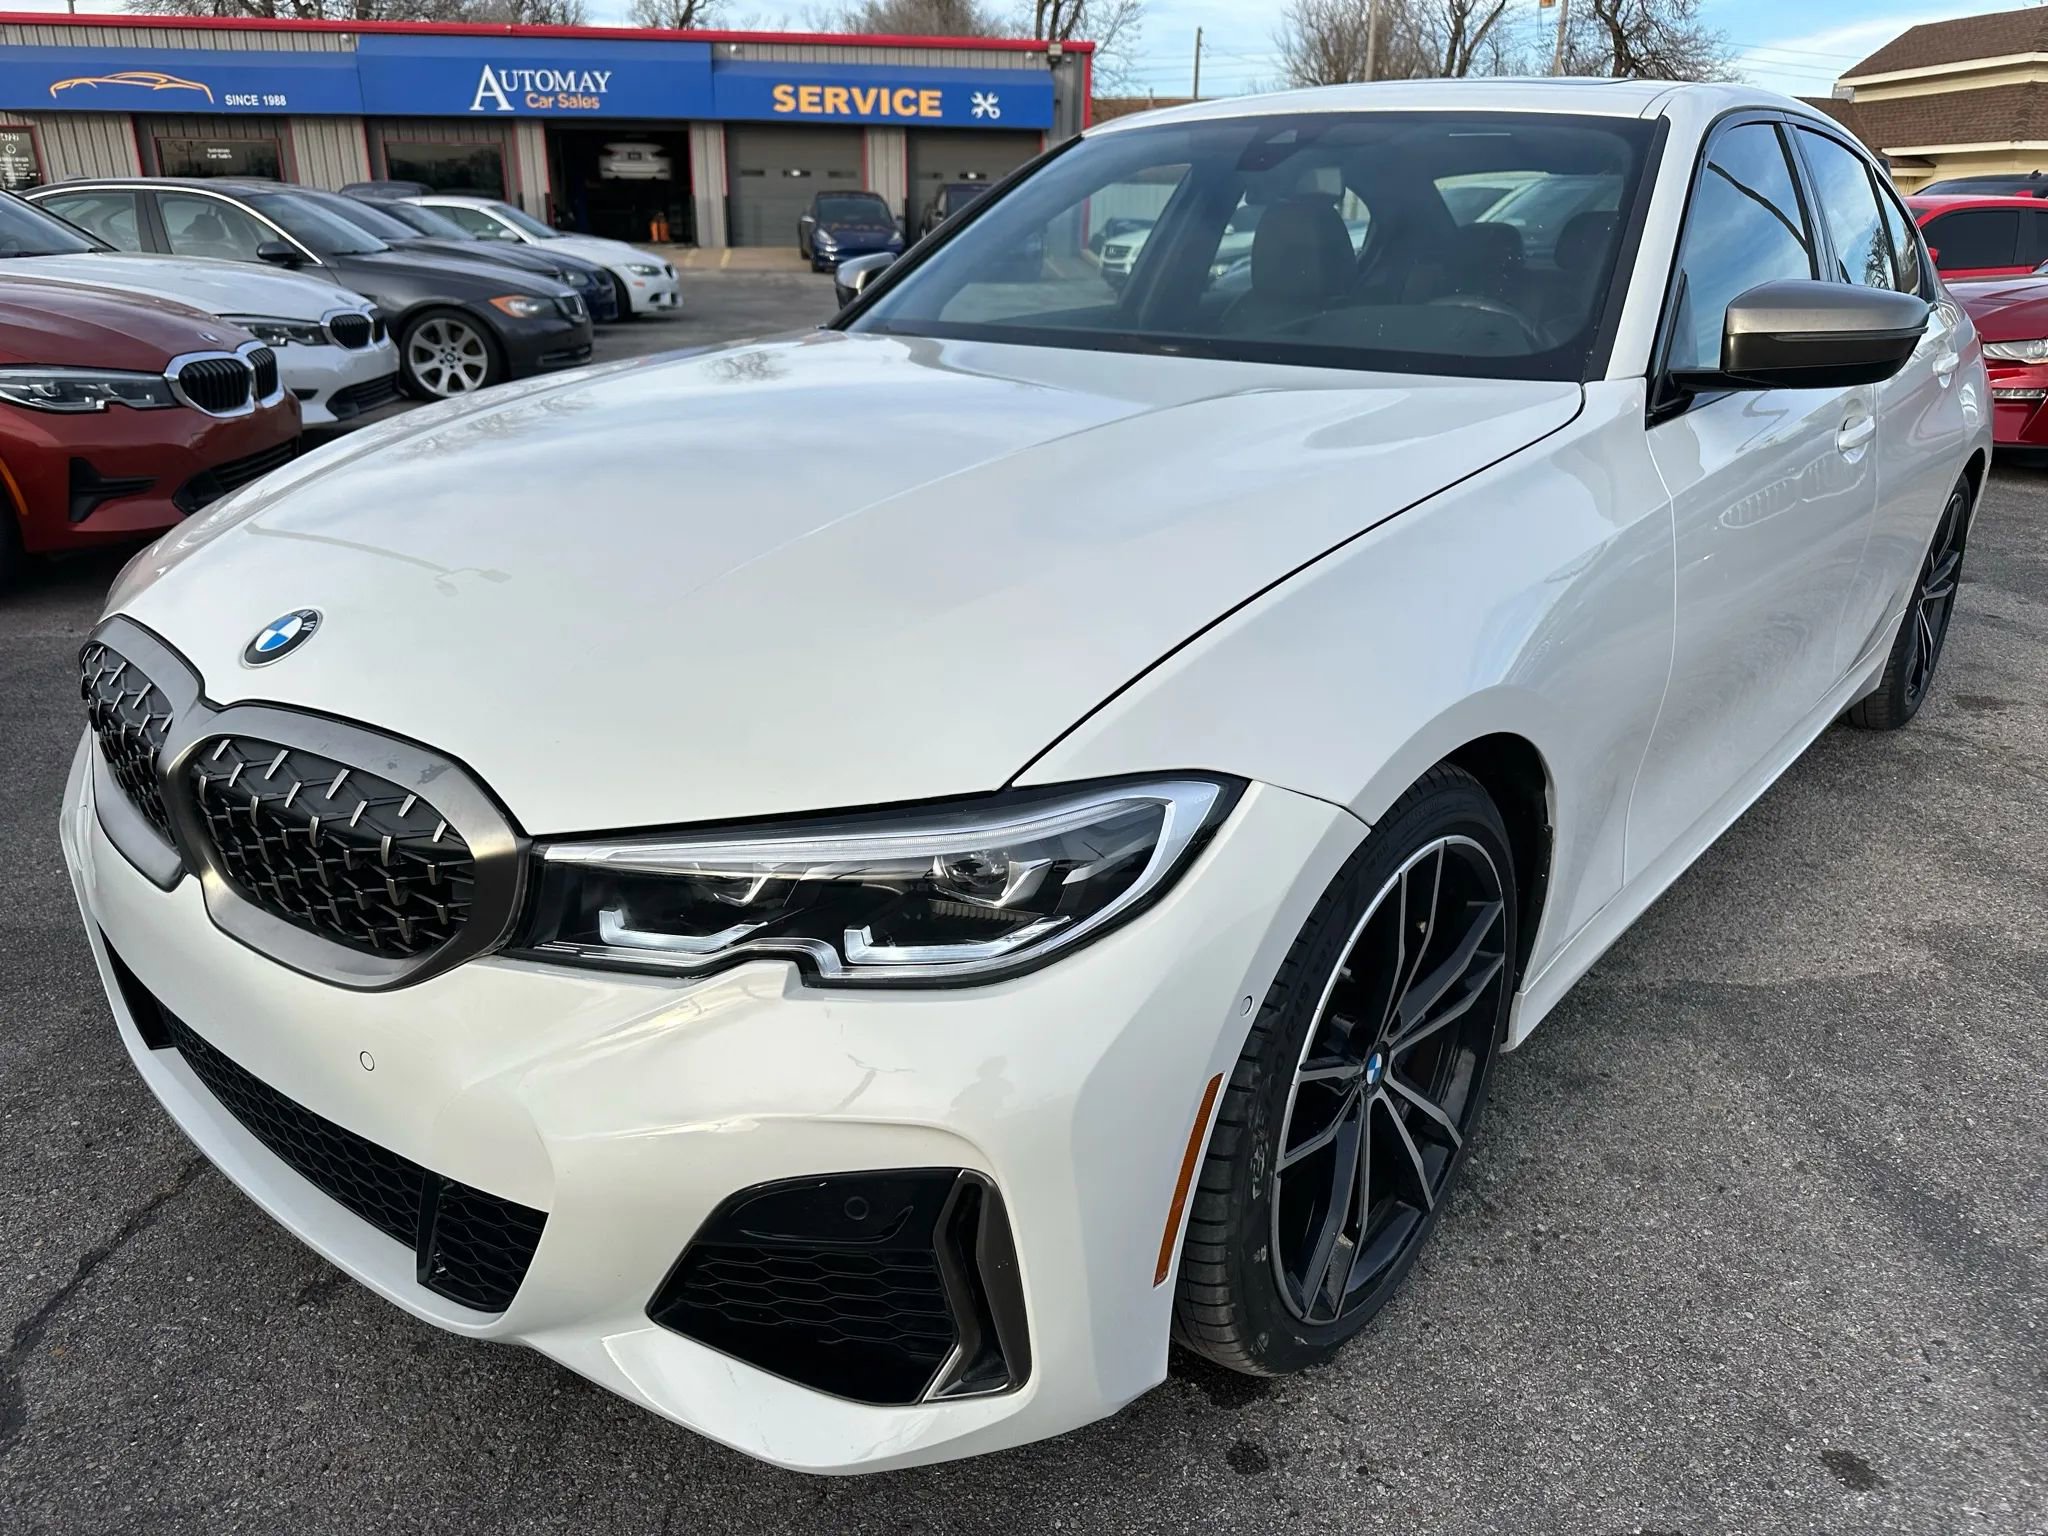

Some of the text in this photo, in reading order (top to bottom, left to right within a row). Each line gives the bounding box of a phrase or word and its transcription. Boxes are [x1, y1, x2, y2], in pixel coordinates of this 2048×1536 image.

[225, 94, 286, 106] SINCE 1988
[469, 64, 612, 111] AUTOMAY
[525, 92, 600, 109] Car Sales
[772, 84, 943, 118] SERVICE
